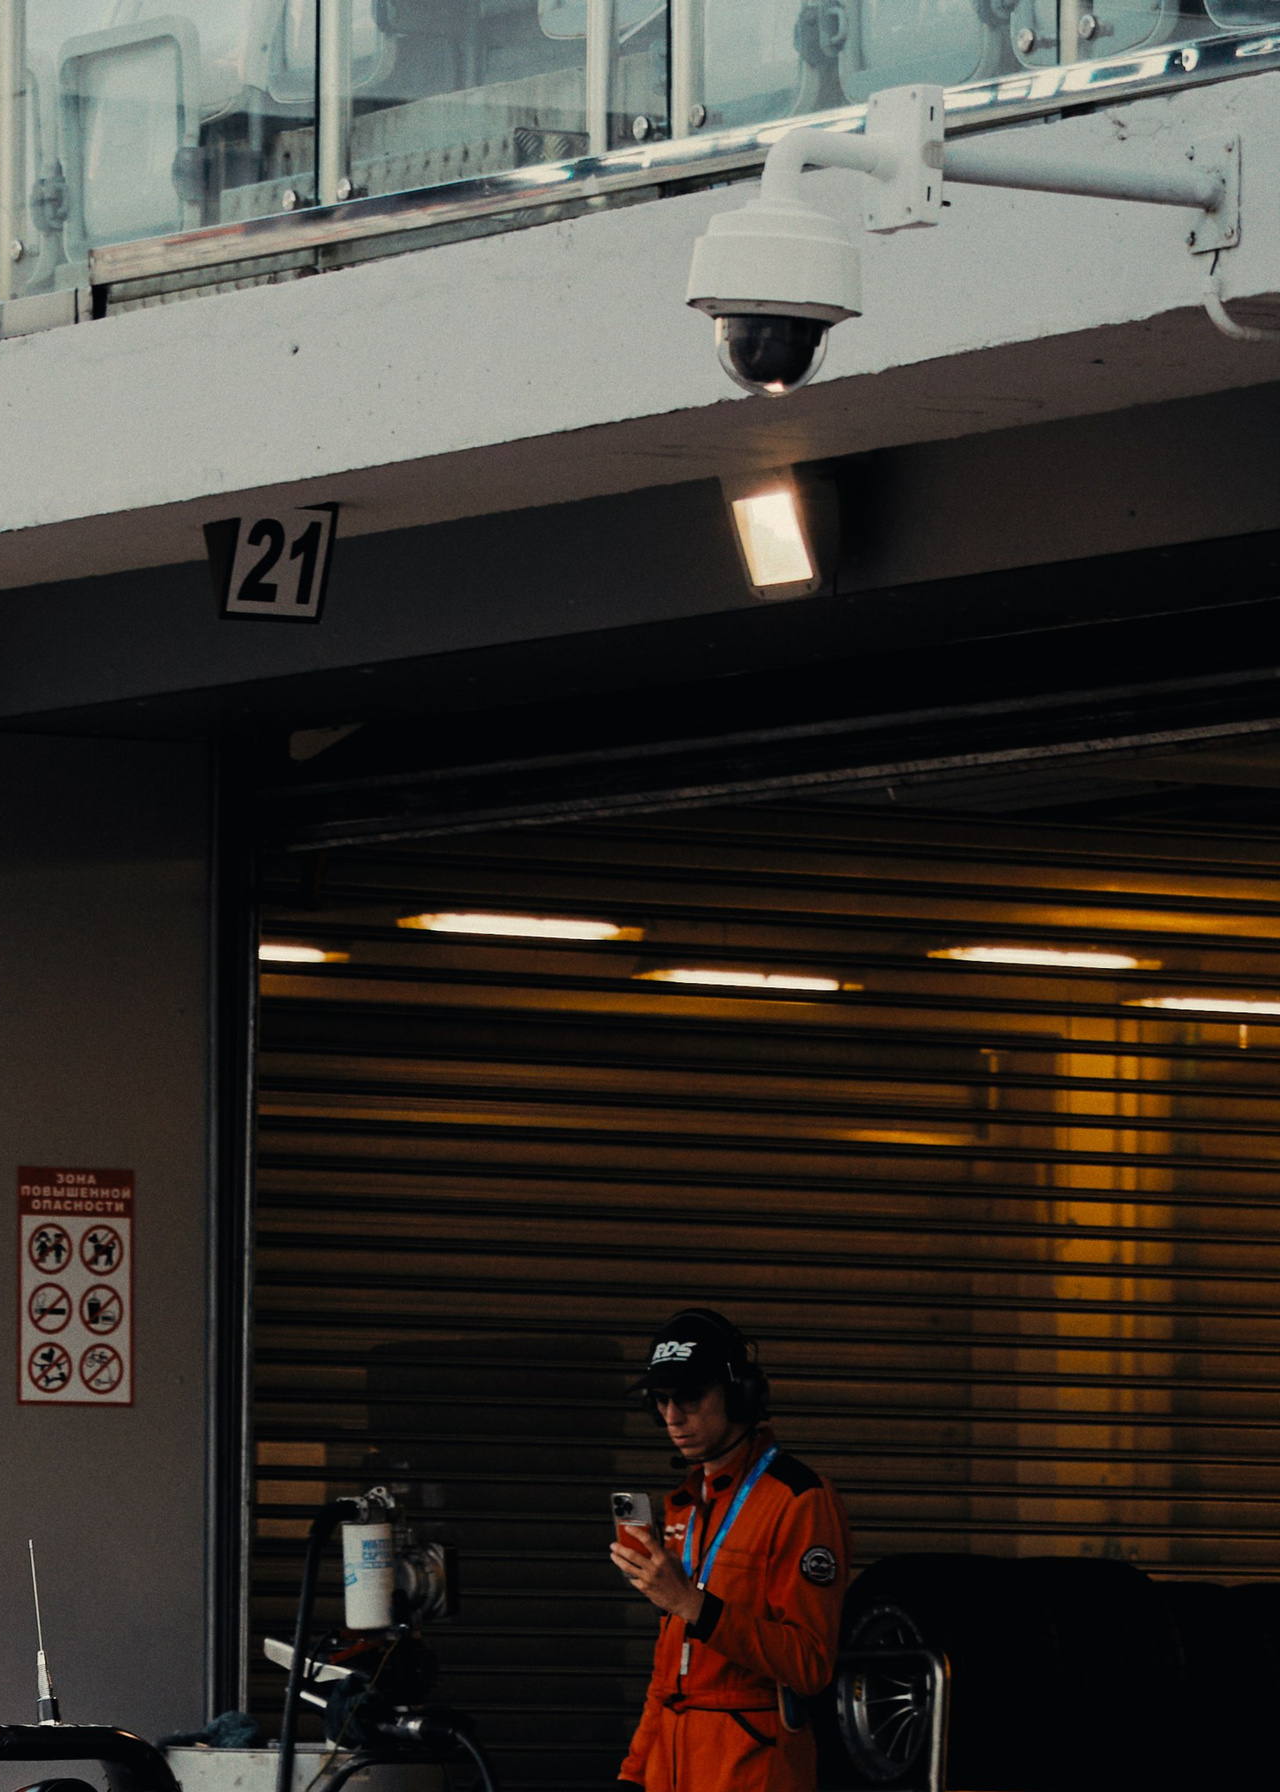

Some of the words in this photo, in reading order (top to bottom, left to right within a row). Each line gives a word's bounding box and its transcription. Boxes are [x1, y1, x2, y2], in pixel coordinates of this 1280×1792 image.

[236, 517, 324, 605] 21
[56, 1173, 97, 1186] ЗОНА
[21, 1185, 132, 1199] ПОВЫШЕННОЙ
[31, 1199, 125, 1212] ОПАСНОСТИ
